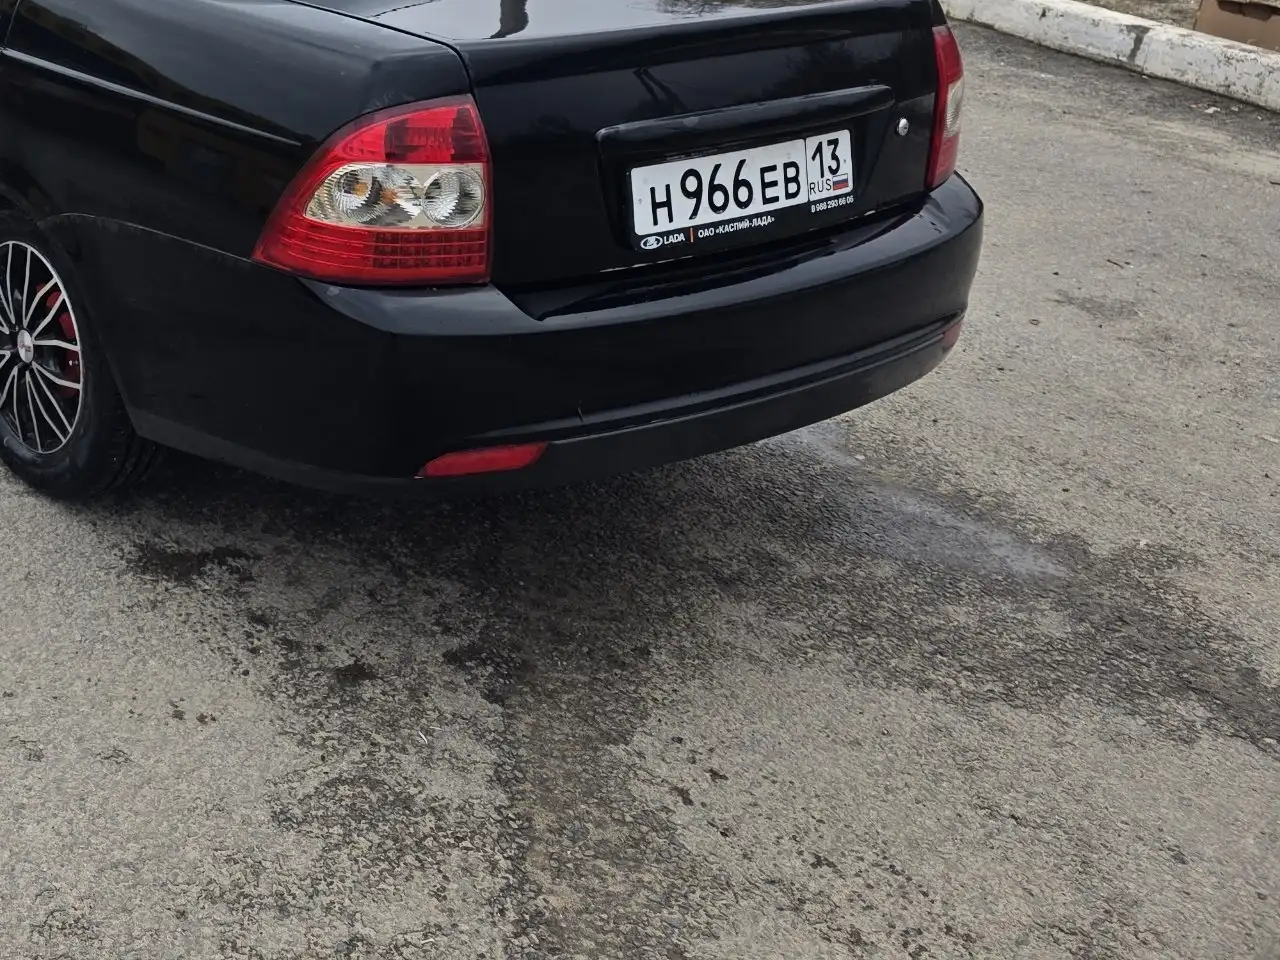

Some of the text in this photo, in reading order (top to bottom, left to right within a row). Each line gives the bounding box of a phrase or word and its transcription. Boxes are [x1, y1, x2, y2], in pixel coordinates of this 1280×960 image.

[811, 138, 840, 178] 13
[809, 178, 832, 195] RUS
[697, 215, 775, 238] ОАО «КАСПИЙ-ЛАДА»
[663, 232, 686, 245] LADA
